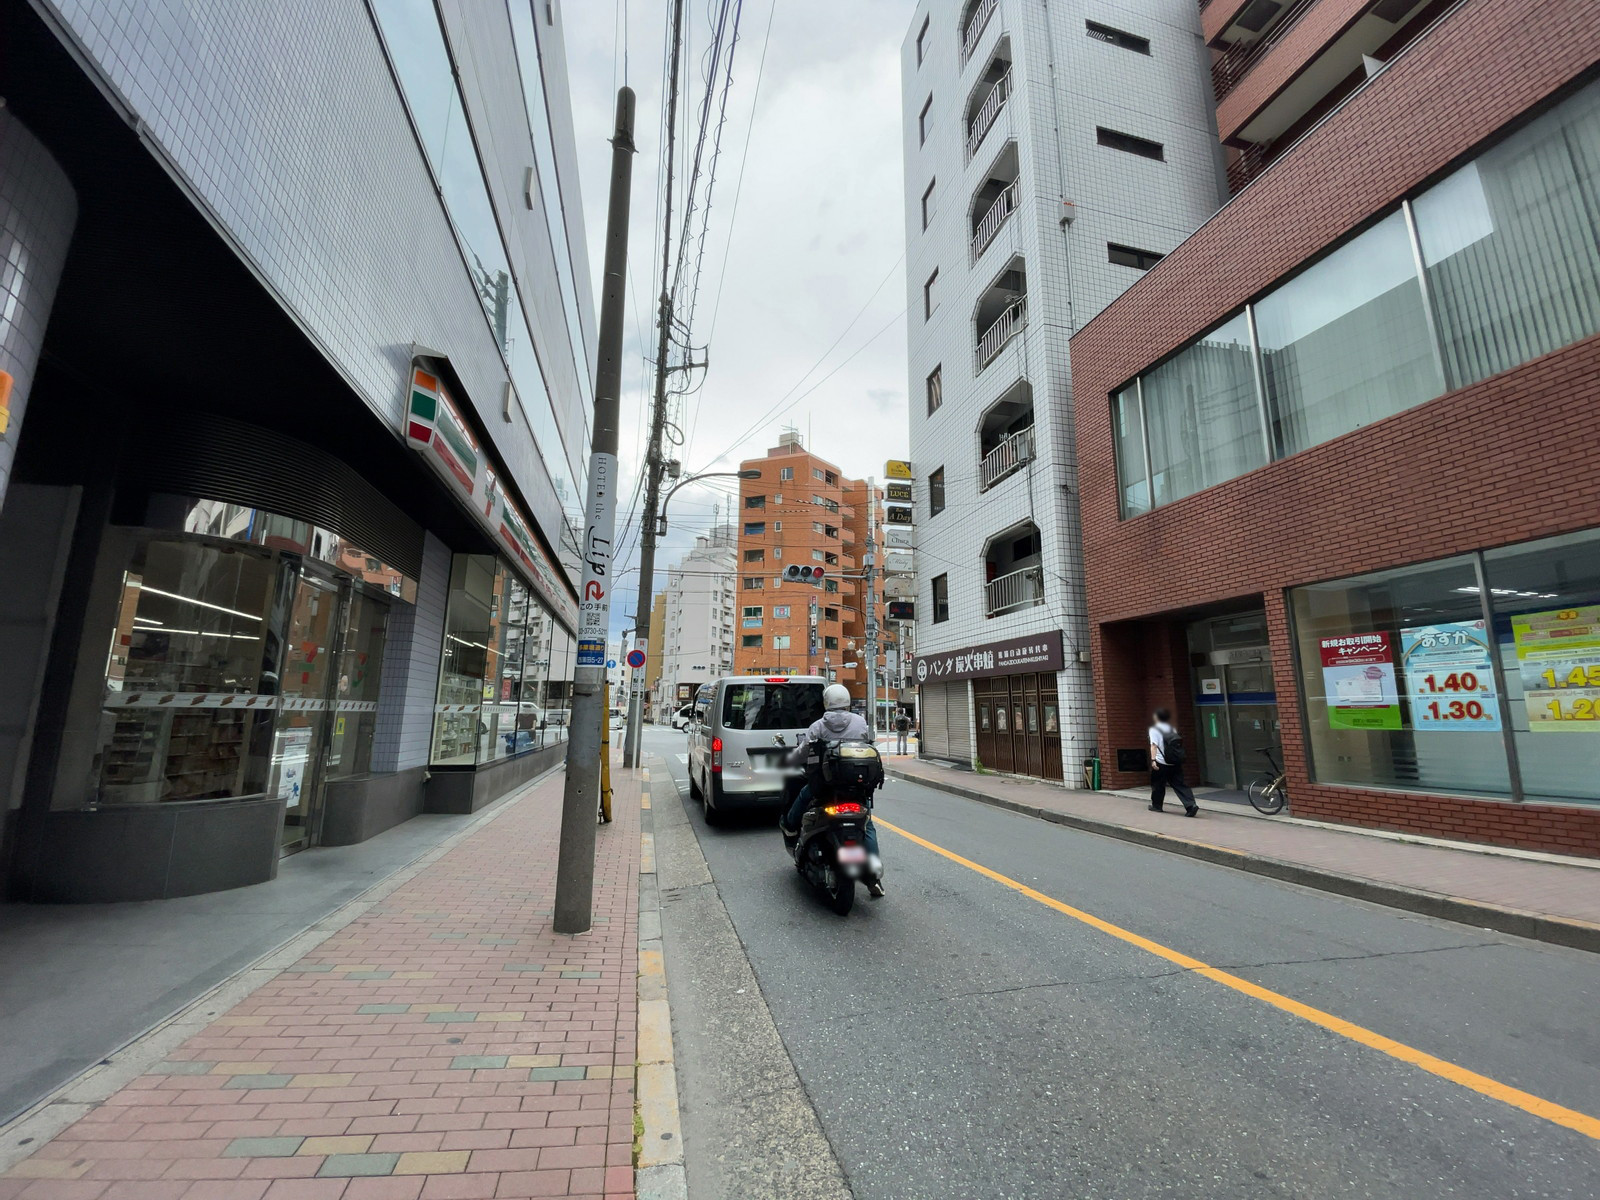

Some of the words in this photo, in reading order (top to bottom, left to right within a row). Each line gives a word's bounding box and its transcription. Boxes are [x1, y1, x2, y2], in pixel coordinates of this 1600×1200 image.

[890, 490, 909, 498] LUCE
[595, 503, 605, 520] the
[896, 513, 912, 523] Day
[584, 525, 611, 577] Lip
[580, 603, 608, 612] この手前
[1321, 634, 1382, 649] 新規お取引開始
[1421, 630, 1469, 648] あすか
[1338, 644, 1387, 656] キャンペーン
